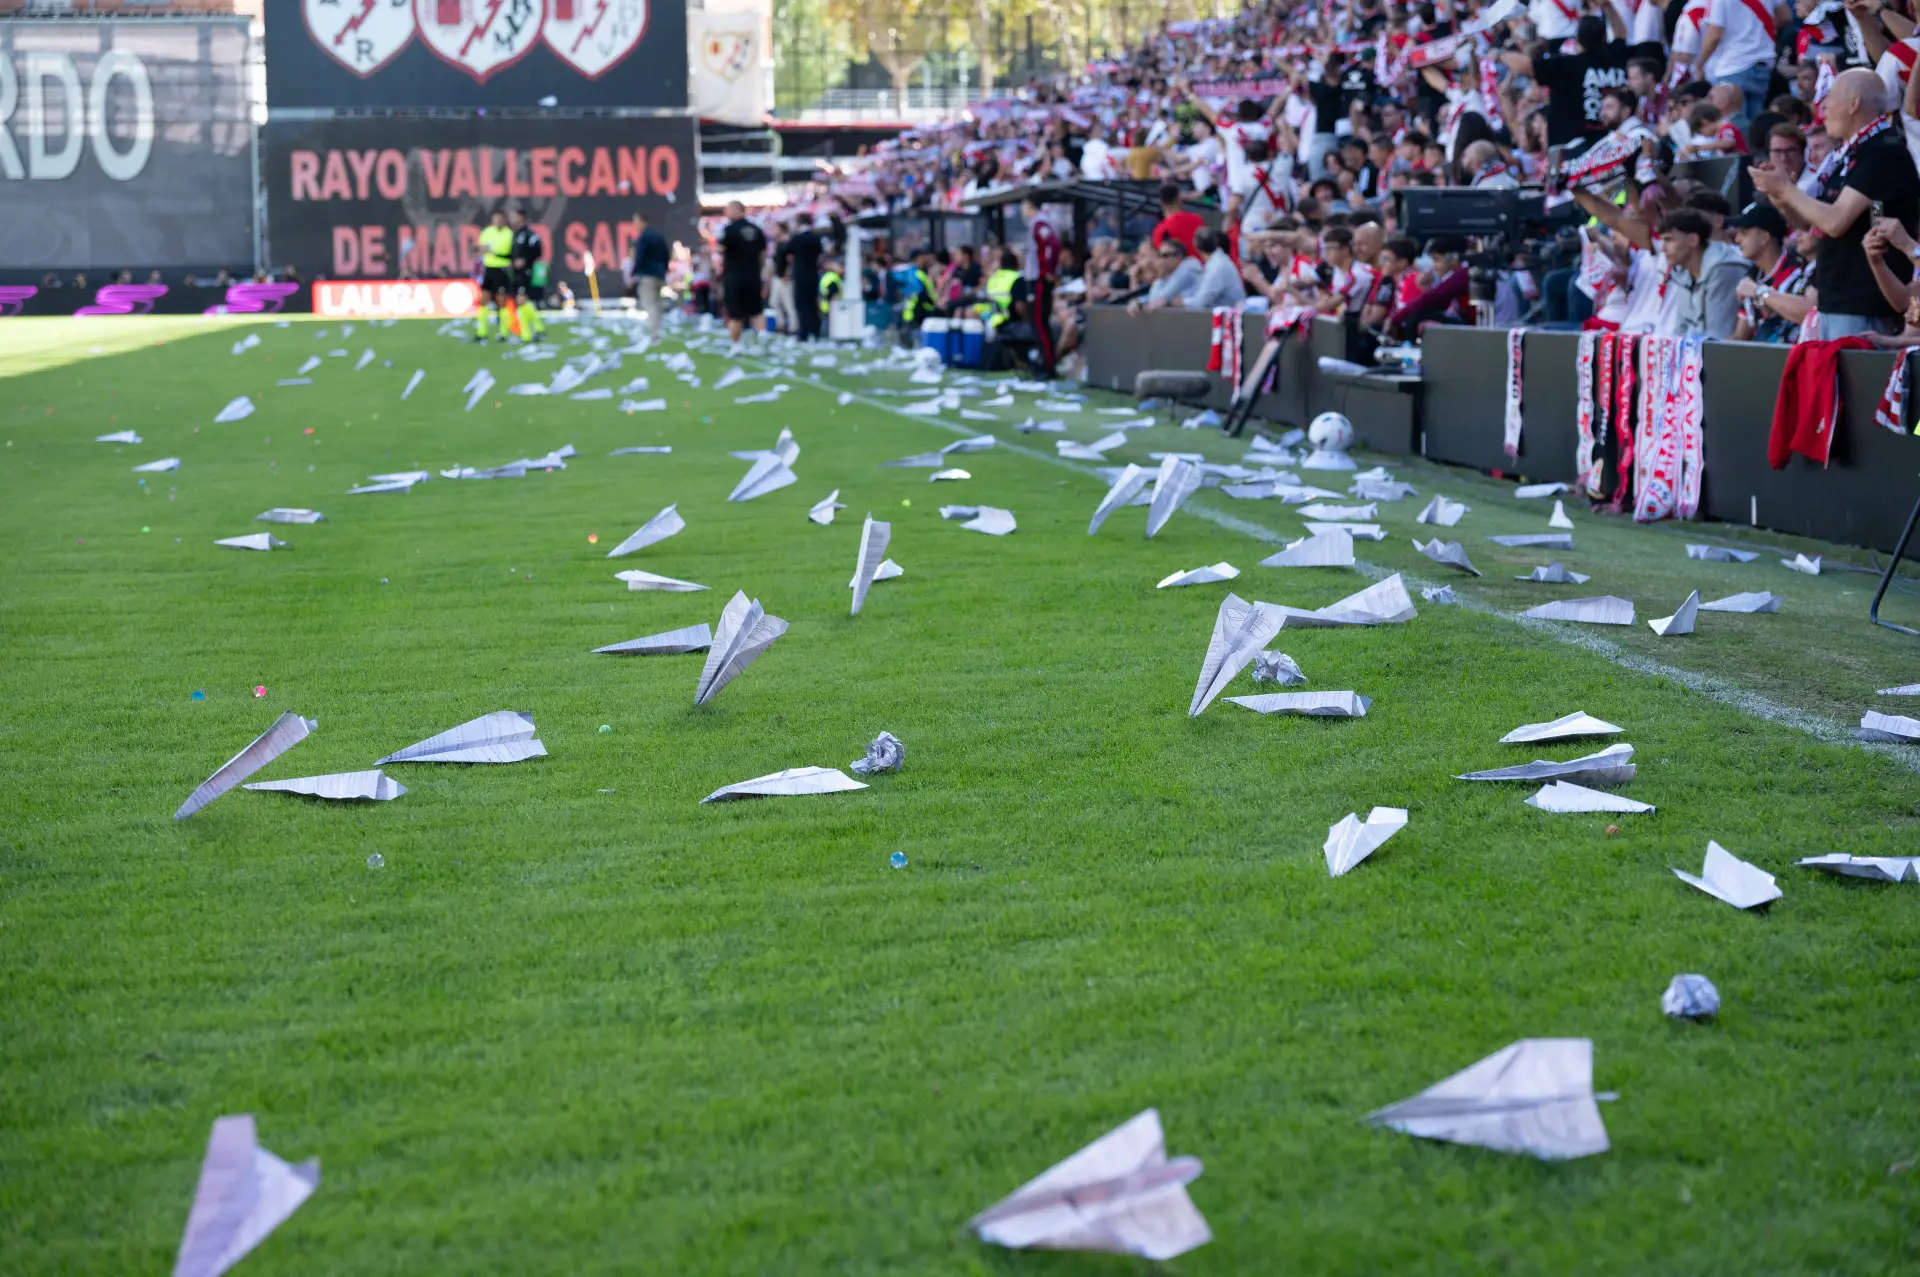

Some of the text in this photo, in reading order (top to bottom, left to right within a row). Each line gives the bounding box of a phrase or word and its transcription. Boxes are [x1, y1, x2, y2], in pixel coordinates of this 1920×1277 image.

[290, 145, 680, 200] RAYO VALLECANO
[333, 225, 387, 276] DE
[397, 223, 553, 276] MAD
[320, 283, 435, 315] LALIGA
[1684, 365, 1695, 450] RAYO
